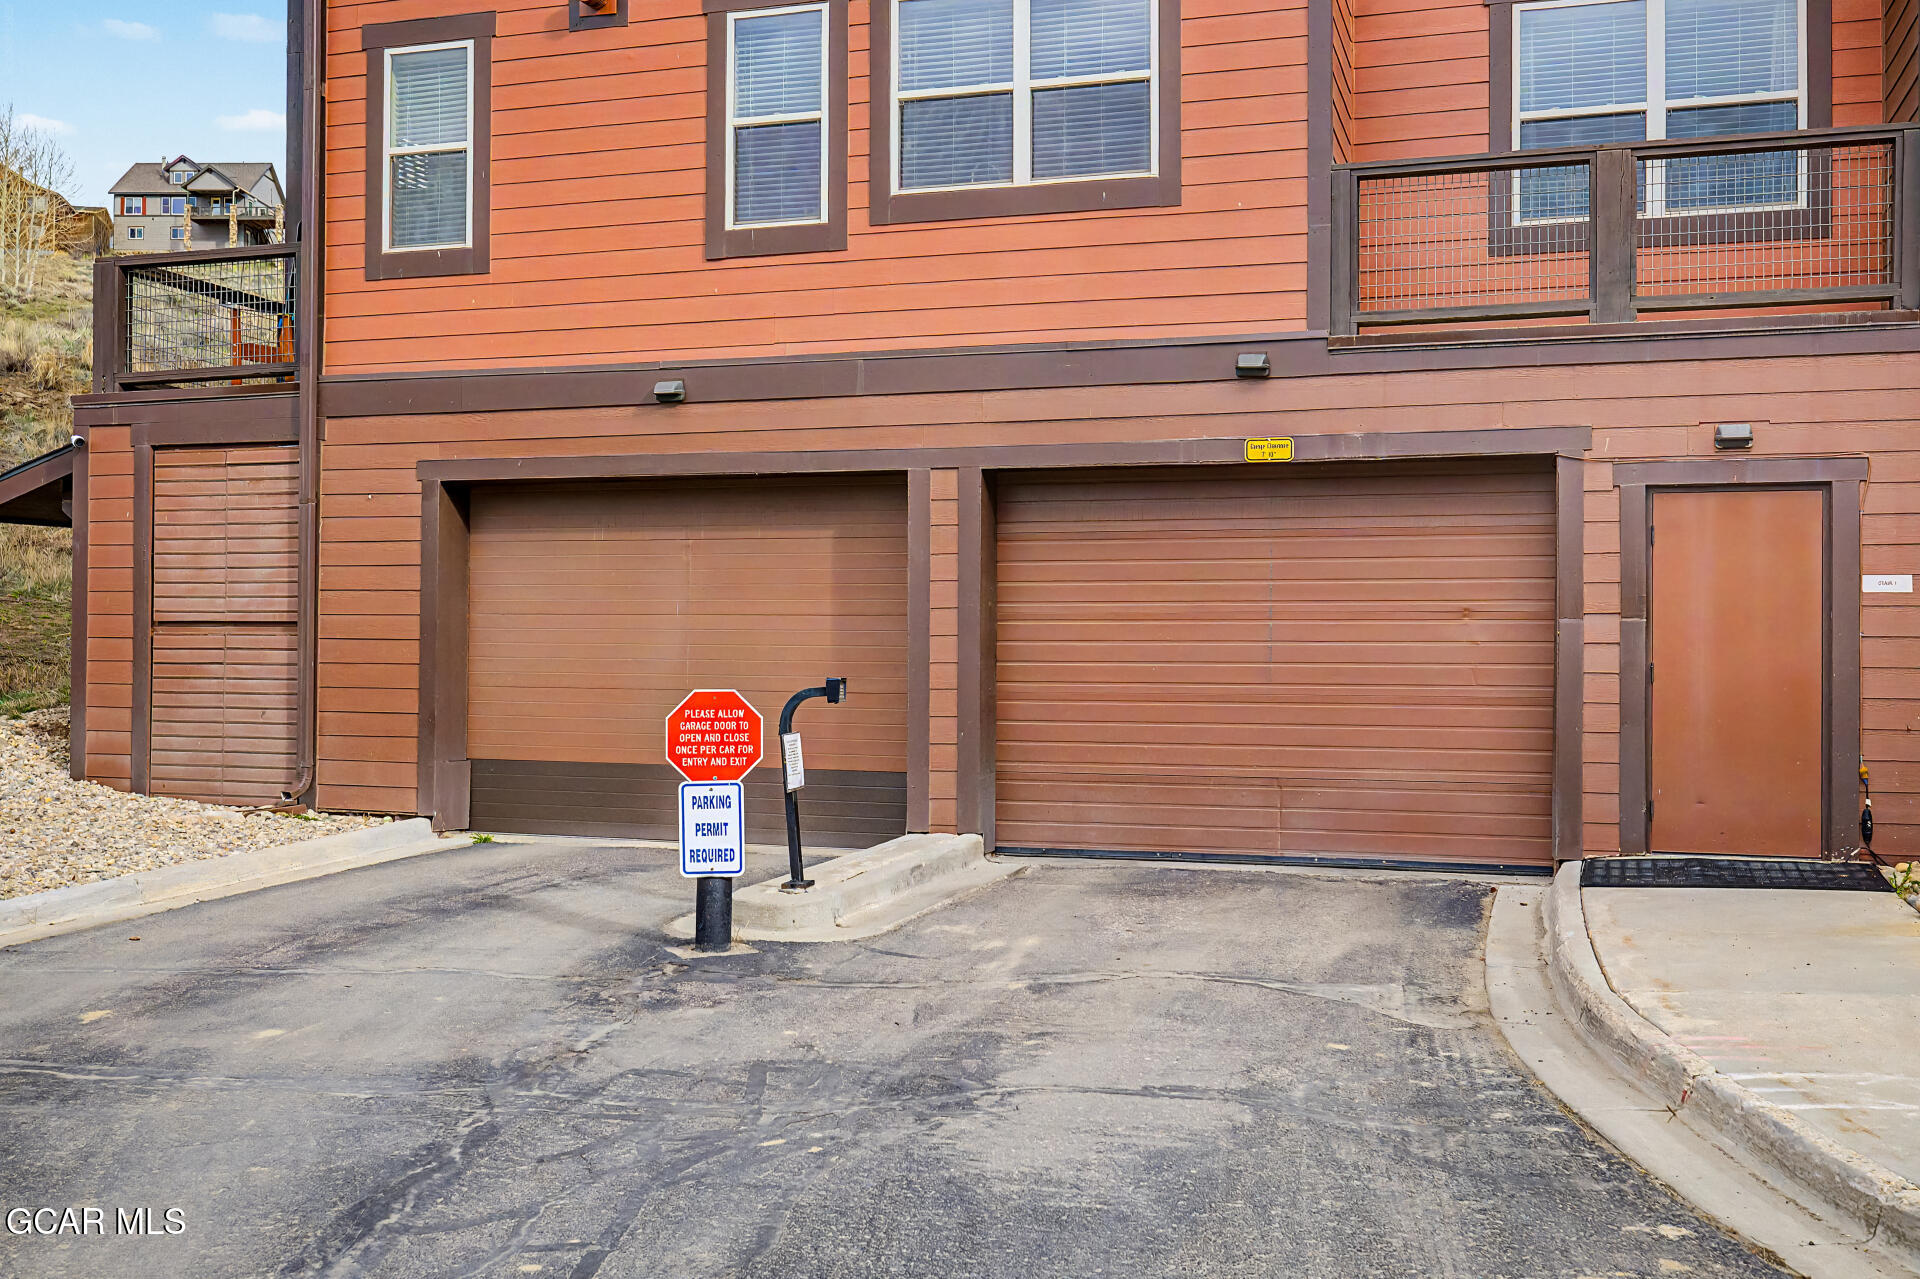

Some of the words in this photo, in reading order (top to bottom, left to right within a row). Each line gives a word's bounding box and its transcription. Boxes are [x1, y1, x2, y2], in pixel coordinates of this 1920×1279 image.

[684, 709, 715, 718] PLEASE
[717, 709, 745, 718] ALLOW
[680, 721, 711, 730] GARAGE
[714, 721, 737, 730] DOOR
[739, 721, 749, 730] TO
[679, 733, 702, 742] OPEN
[704, 733, 721, 742] AND
[723, 733, 750, 742] CLOSE
[675, 745, 698, 754] ONCE
[700, 745, 717, 754] PER
[719, 745, 735, 754] CAR
[737, 745, 754, 754] FOR
[682, 757, 708, 766] ENTRY
[710, 757, 727, 766] AND
[730, 757, 747, 766] EXIT
[691, 795, 732, 810] PARKING
[695, 822, 729, 837] PERMIT
[689, 848, 735, 863] REQUIRED
